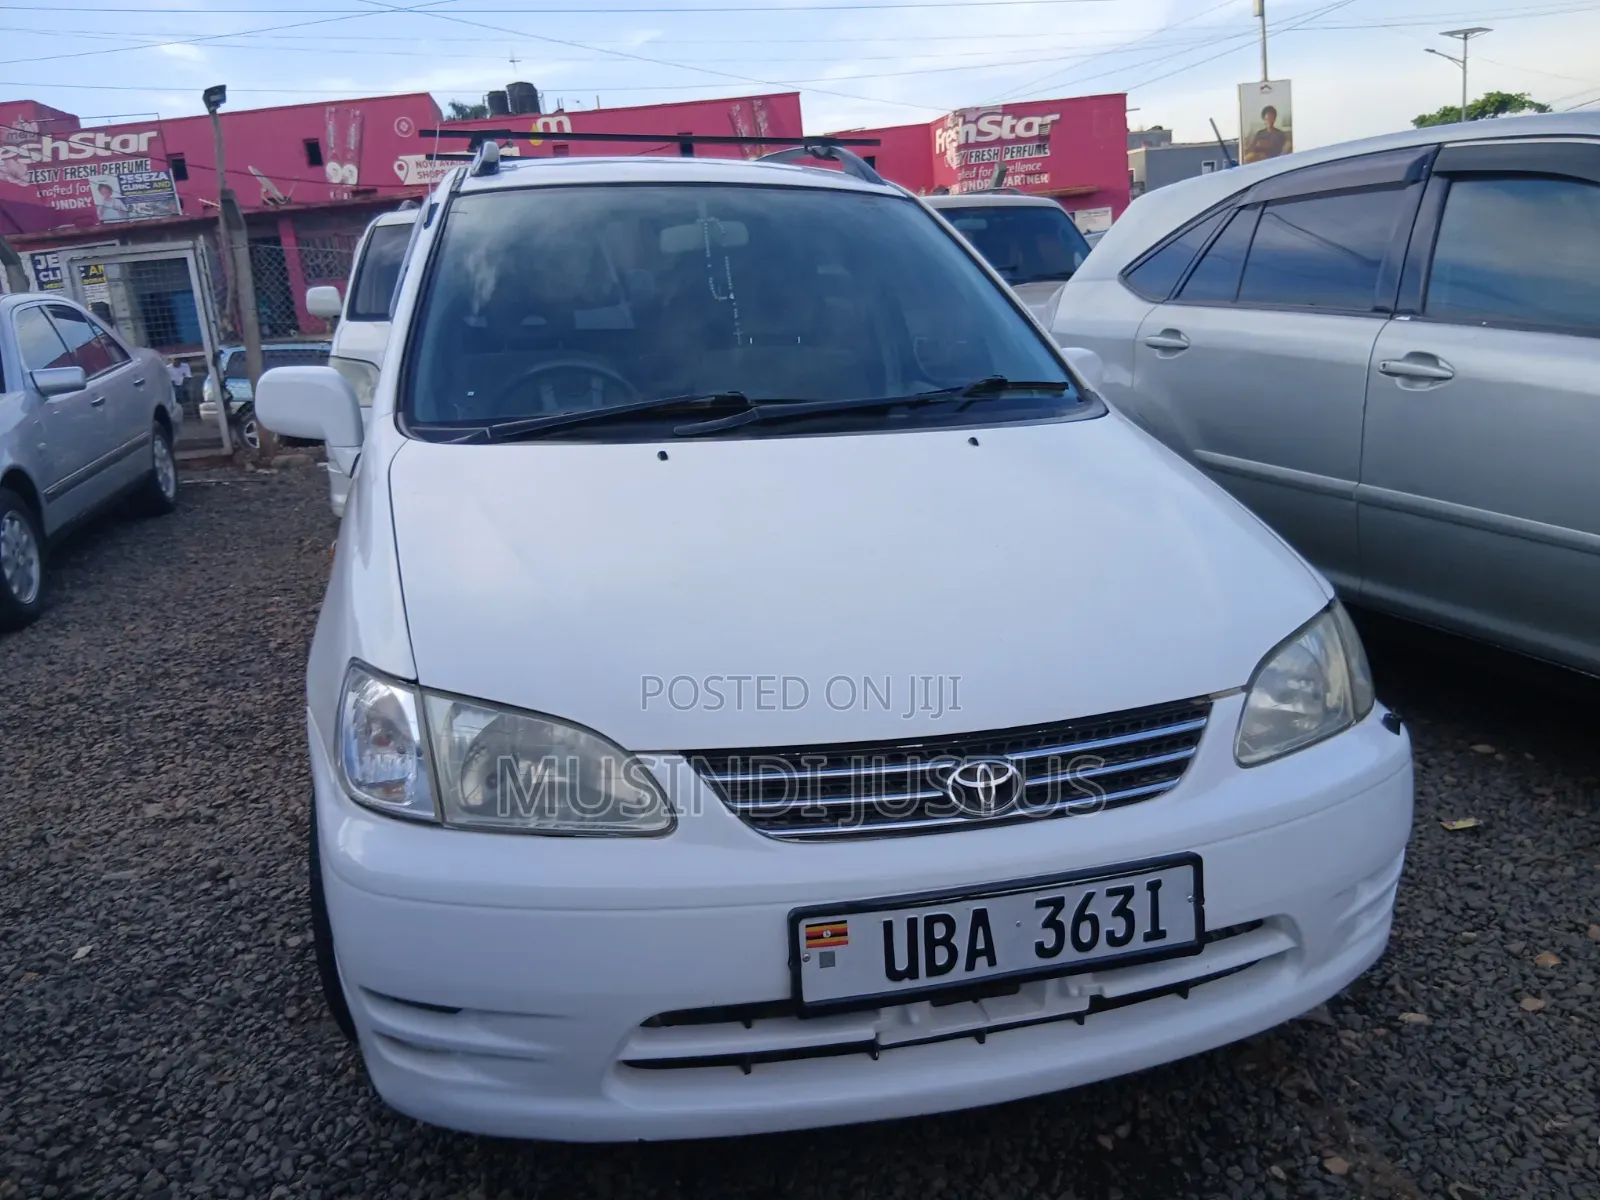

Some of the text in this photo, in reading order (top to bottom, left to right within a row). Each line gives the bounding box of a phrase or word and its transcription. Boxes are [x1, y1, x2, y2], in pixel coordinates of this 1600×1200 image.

[935, 113, 1060, 154] FreshStar
[968, 148, 999, 163] FRESH
[1003, 143, 1049, 159] PERFUME
[28, 159, 150, 183] ZESTY FRESH PERFUME
[120, 172, 169, 184] JESEZA
[978, 165, 993, 179] for
[75, 182, 91, 195] for
[122, 182, 151, 191] CLINIC
[882, 907, 998, 982] UBA
